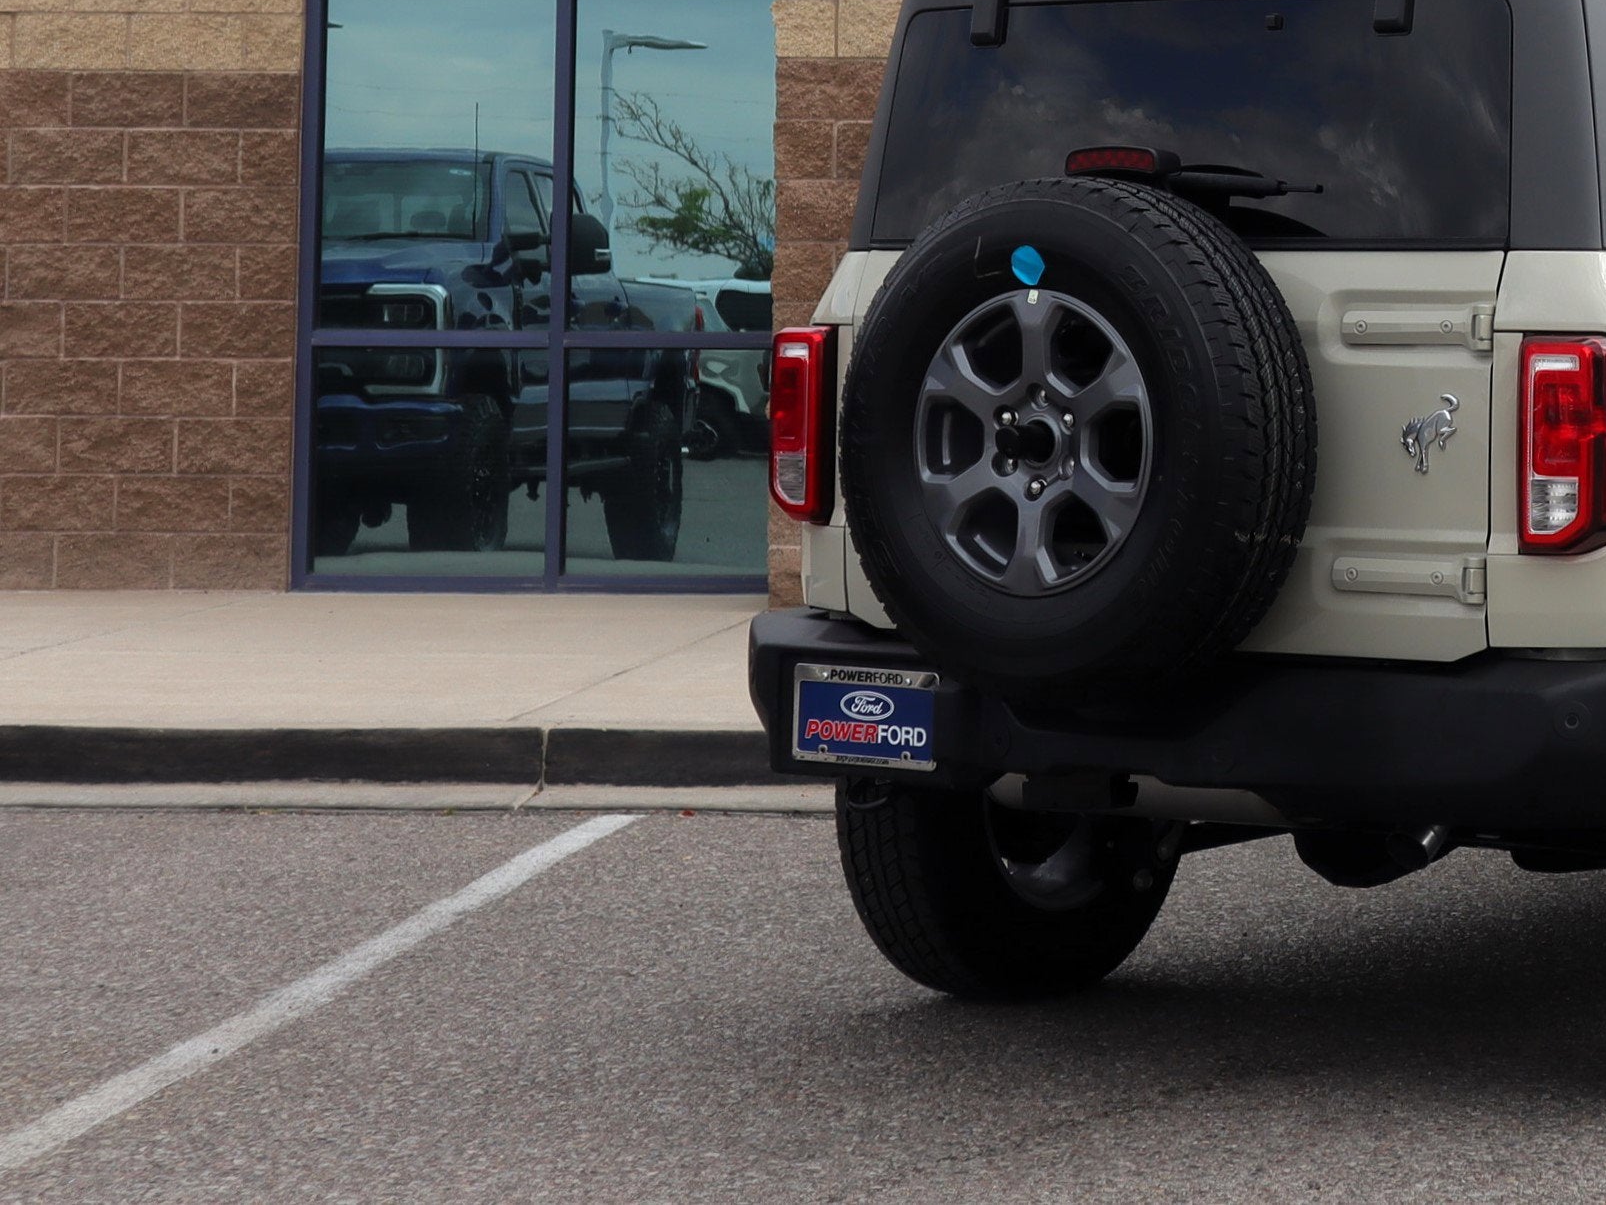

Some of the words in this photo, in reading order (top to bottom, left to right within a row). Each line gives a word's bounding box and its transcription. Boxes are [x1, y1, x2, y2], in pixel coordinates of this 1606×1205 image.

[830, 669, 903, 685] POWERFORD
[851, 696, 883, 714] Ford
[805, 718, 926, 747] POWERFORD
